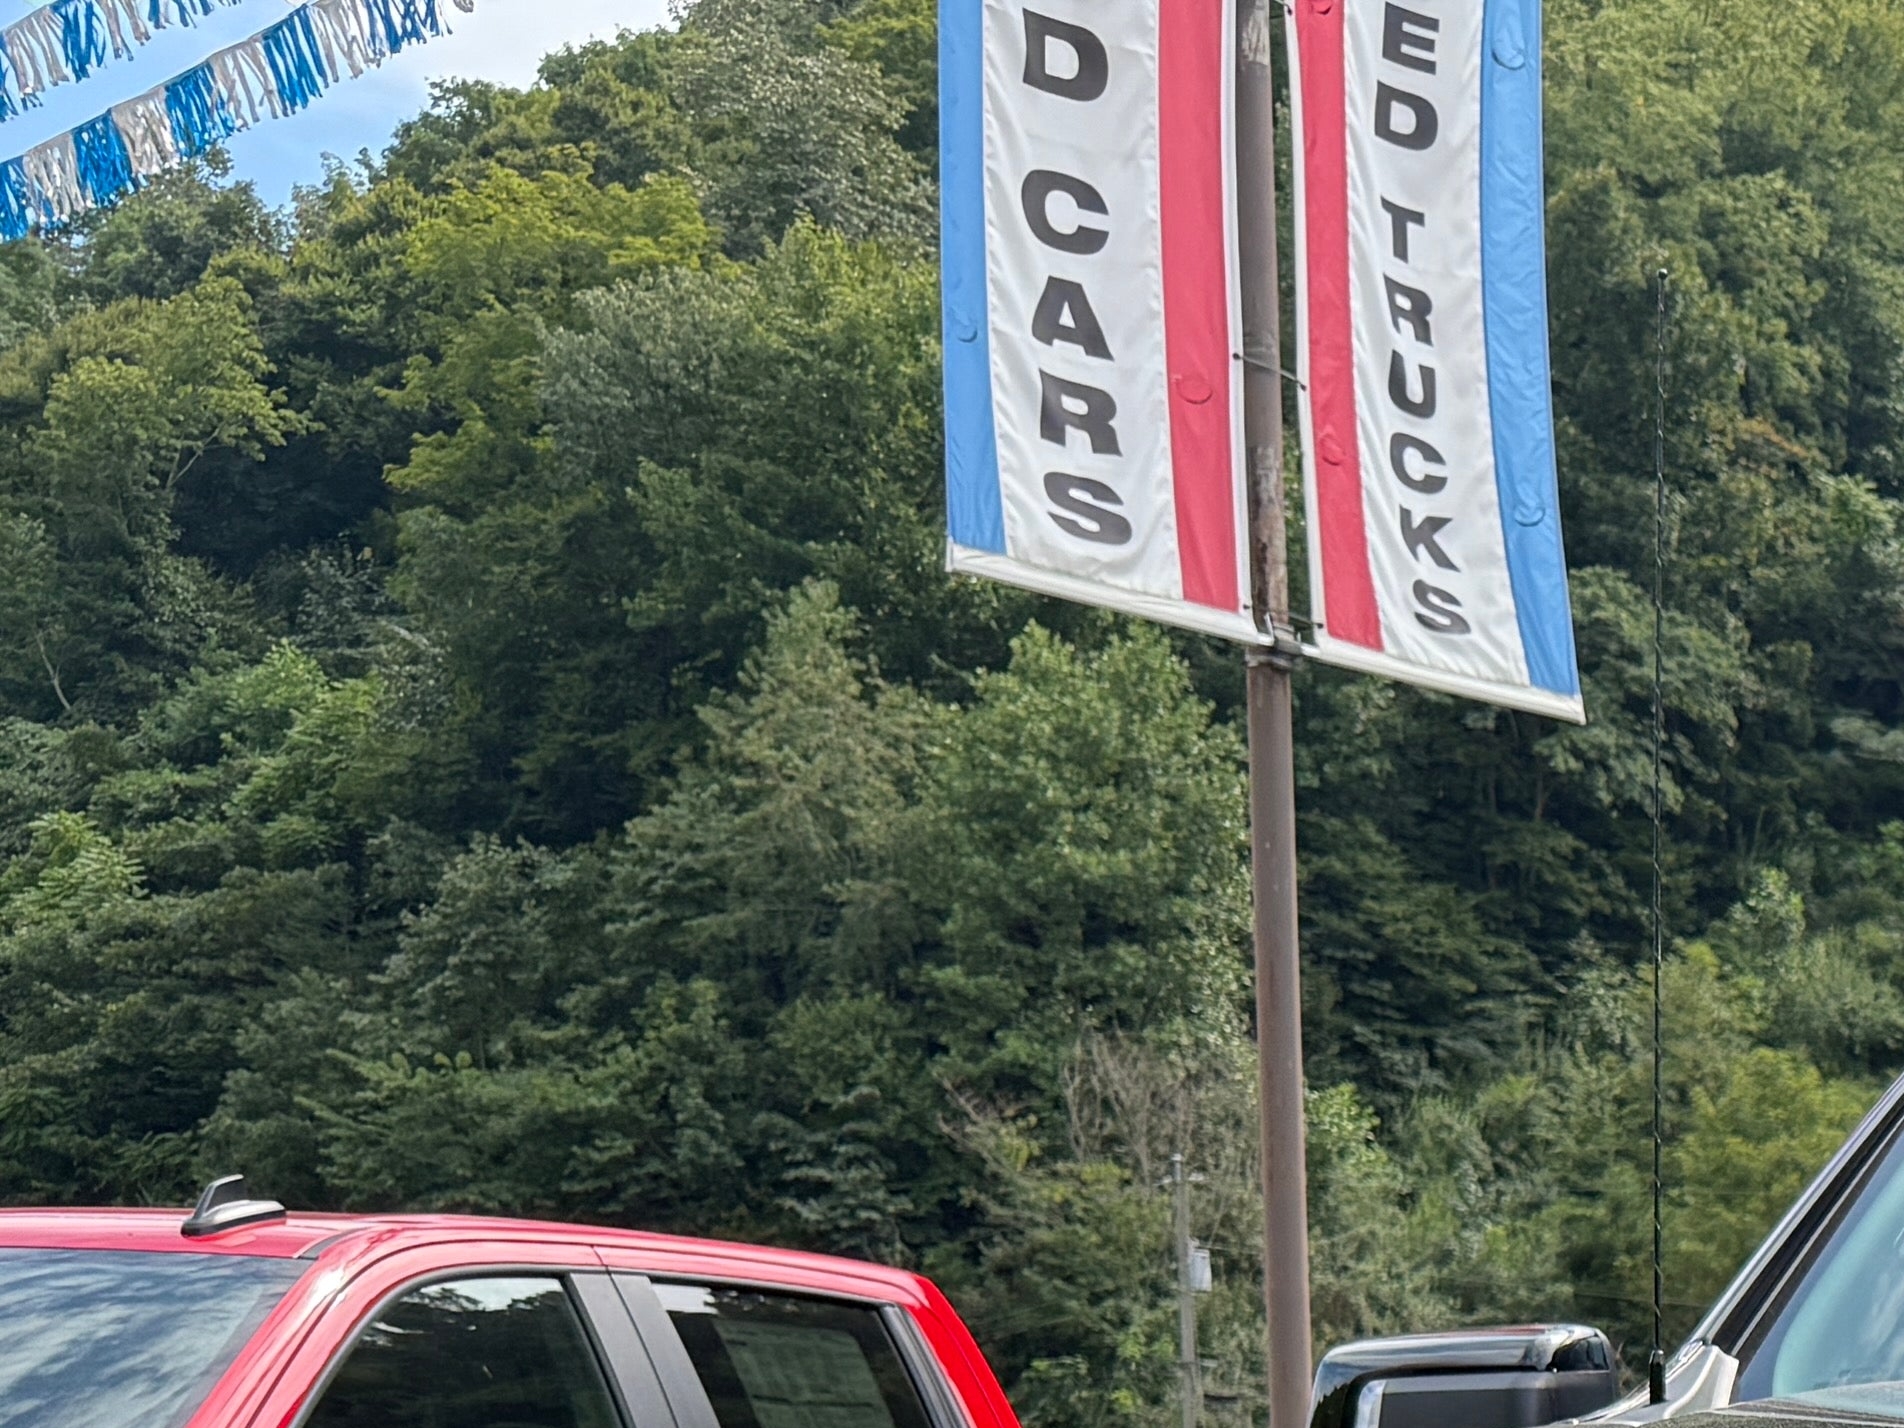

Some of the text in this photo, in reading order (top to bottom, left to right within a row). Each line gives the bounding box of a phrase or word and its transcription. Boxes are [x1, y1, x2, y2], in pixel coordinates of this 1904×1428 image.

[1020, 169, 1132, 545] CARS
[1374, 1, 1471, 635] ED TRUCKS
